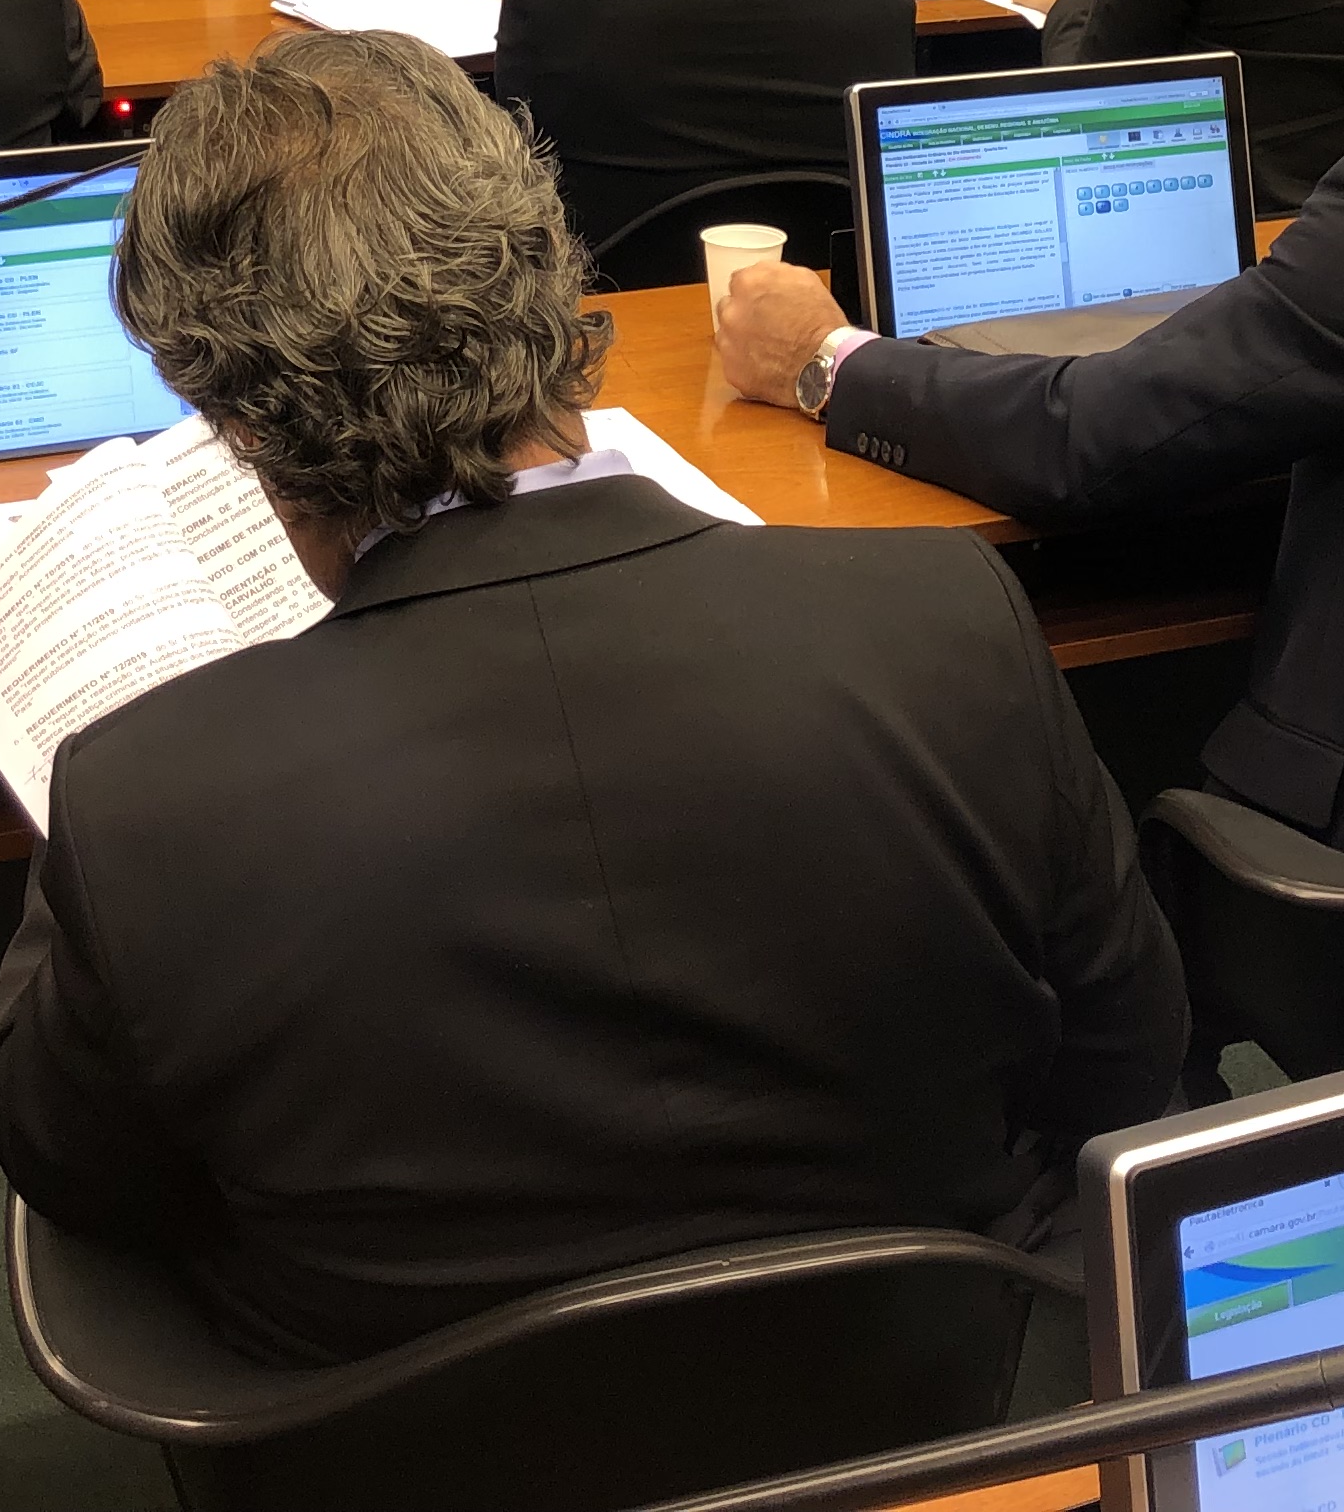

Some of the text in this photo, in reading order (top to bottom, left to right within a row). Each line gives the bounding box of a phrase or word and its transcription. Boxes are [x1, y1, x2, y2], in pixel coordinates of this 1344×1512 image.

[177, 483, 225, 514] Constituição
[218, 503, 233, 514] DE
[196, 538, 233, 564] REGIME
[232, 531, 247, 544] DE
[237, 549, 258, 566] COM
[259, 544, 267, 552] O
[219, 553, 296, 601] ORIENTAÇÃO DA
[225, 577, 277, 610] CARVALHO:
[230, 585, 285, 619] Considerando
[287, 575, 302, 587] que
[237, 607, 269, 629] entendo
[273, 595, 288, 608] que
[303, 600, 323, 614] Voto
[243, 613, 279, 639] prosperar
[289, 601, 299, 610] no
[1, 638, 68, 697] REQUERIMENTO
[26, 679, 98, 735] REQUERIMENTO
[1255, 1423, 1308, 1447] Plenário
[1312, 1415, 1330, 1428] CD
